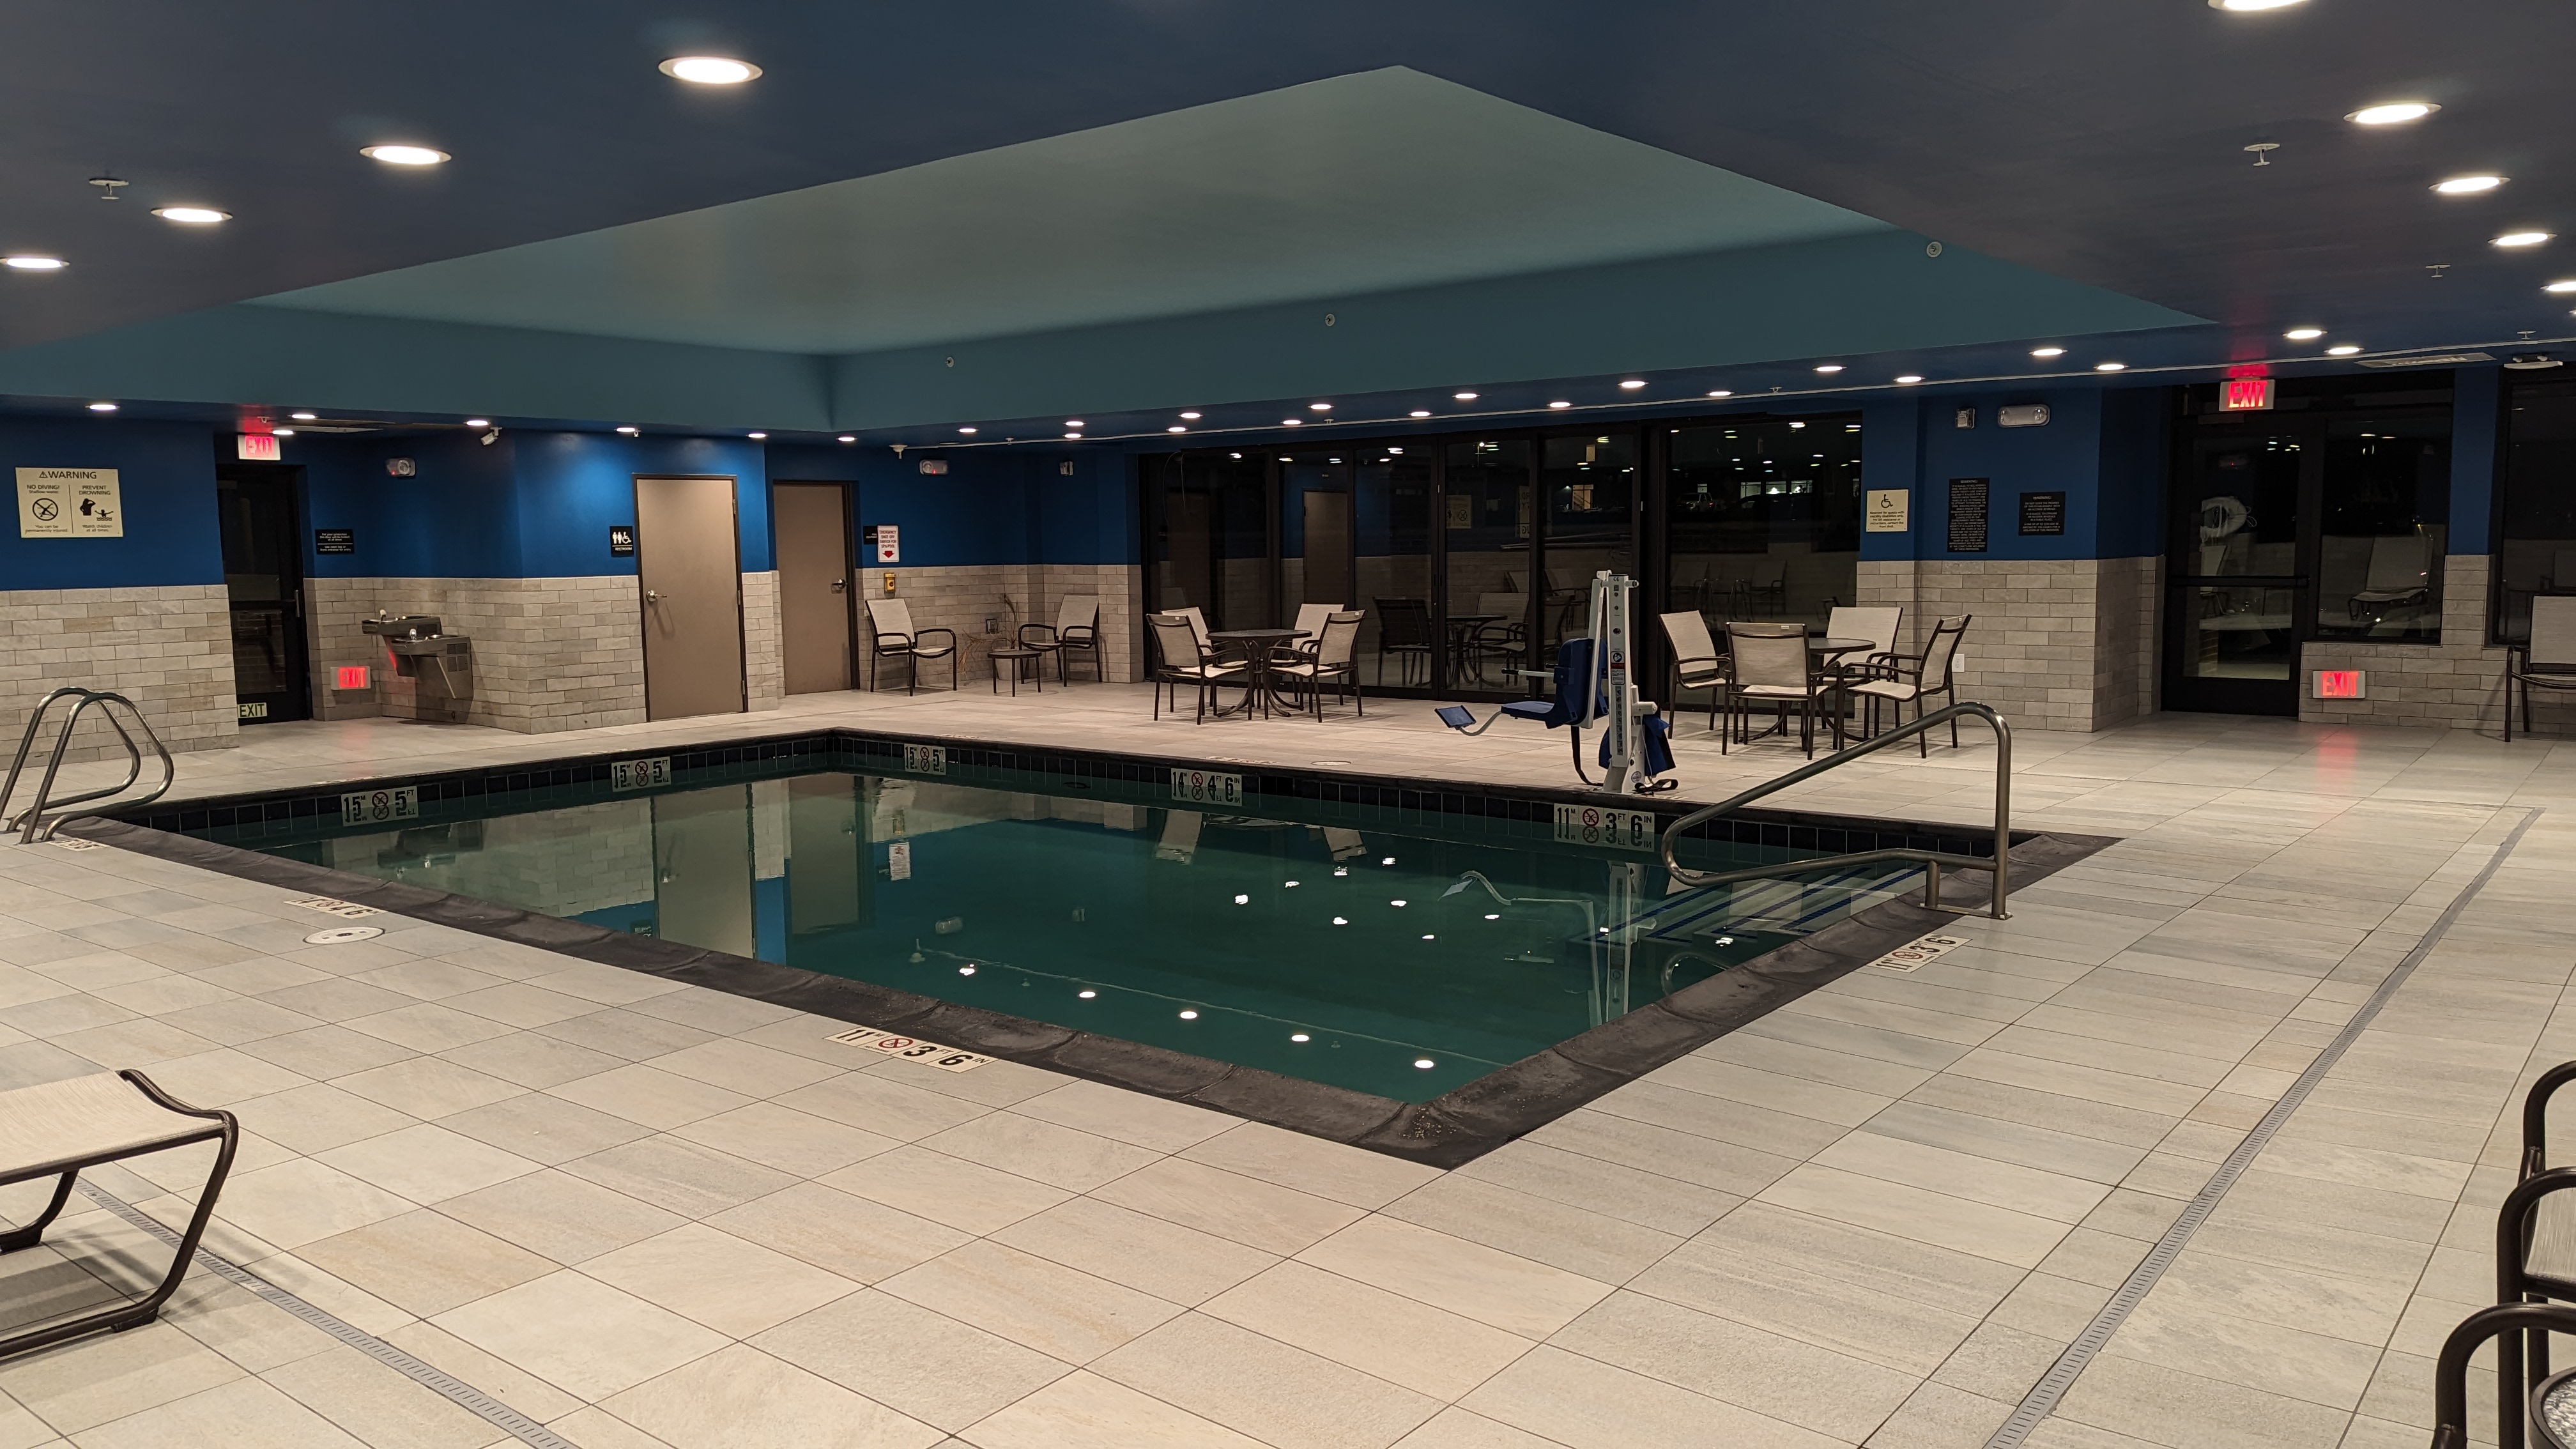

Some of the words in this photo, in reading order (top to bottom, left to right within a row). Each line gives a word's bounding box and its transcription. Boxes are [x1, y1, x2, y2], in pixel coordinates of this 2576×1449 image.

[2228, 381, 2267, 408] EXIT
[245, 435, 273, 458] EXIT
[339, 667, 365, 688] EXIT
[2322, 671, 2359, 696] EXIT
[240, 703, 264, 717] EXIT
[1207, 775, 1216, 788] 4
[1225, 777, 1234, 790] 6
[1605, 812, 1617, 829] 3
[1630, 815, 1643, 832] 6
[1643, 815, 1652, 824] IN
[903, 1046, 938, 1057] 3
[938, 1054, 974, 1066] 6
[971, 1056, 990, 1064] IN
